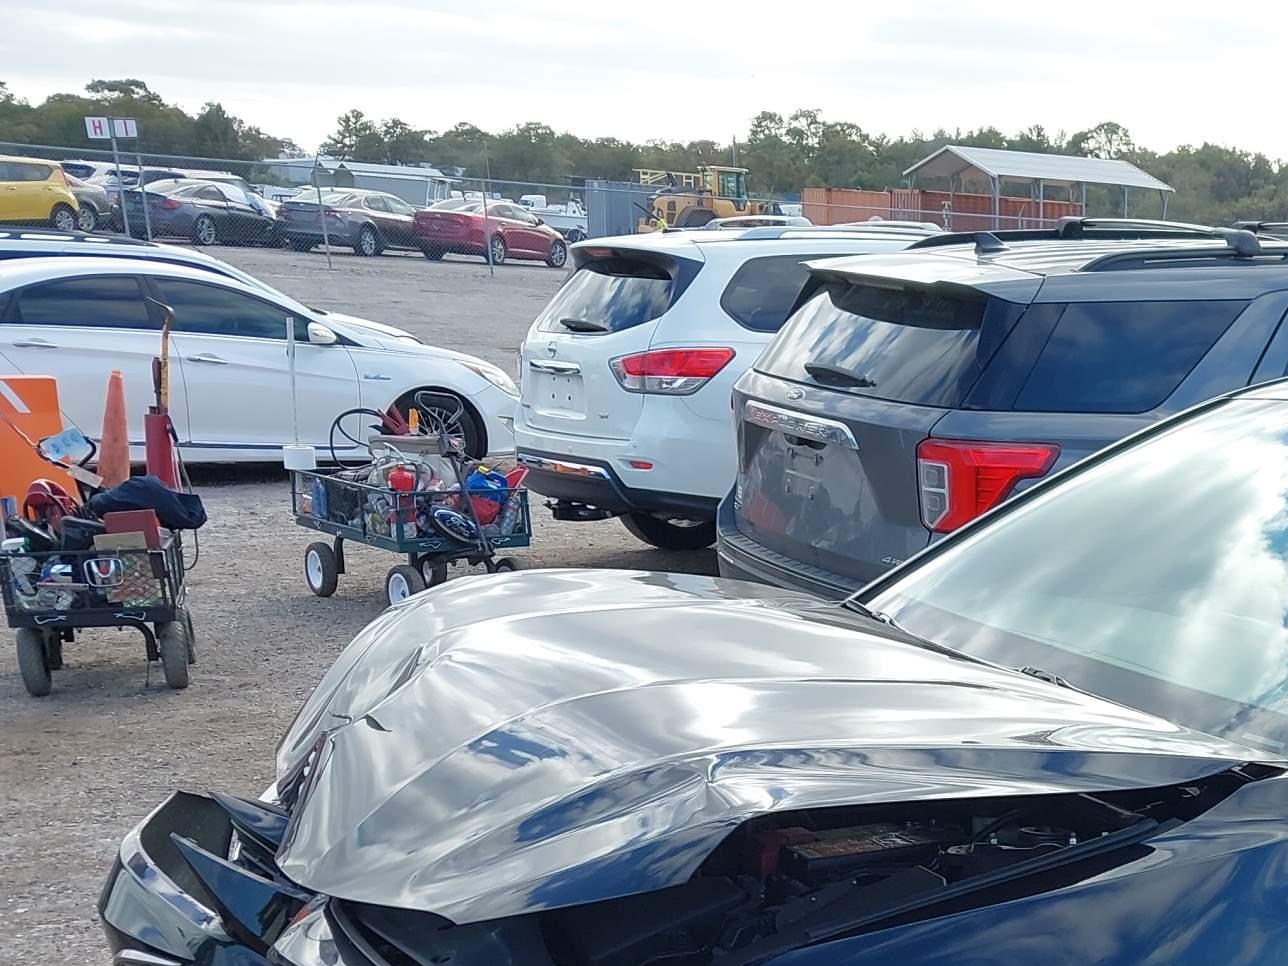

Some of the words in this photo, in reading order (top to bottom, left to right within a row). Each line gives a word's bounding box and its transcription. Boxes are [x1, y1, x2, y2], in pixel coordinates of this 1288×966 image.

[92, 119, 103, 137] H
[751, 407, 829, 438] EXPLORER
[445, 516, 471, 538] Ford
[881, 556, 904, 567] 4W
